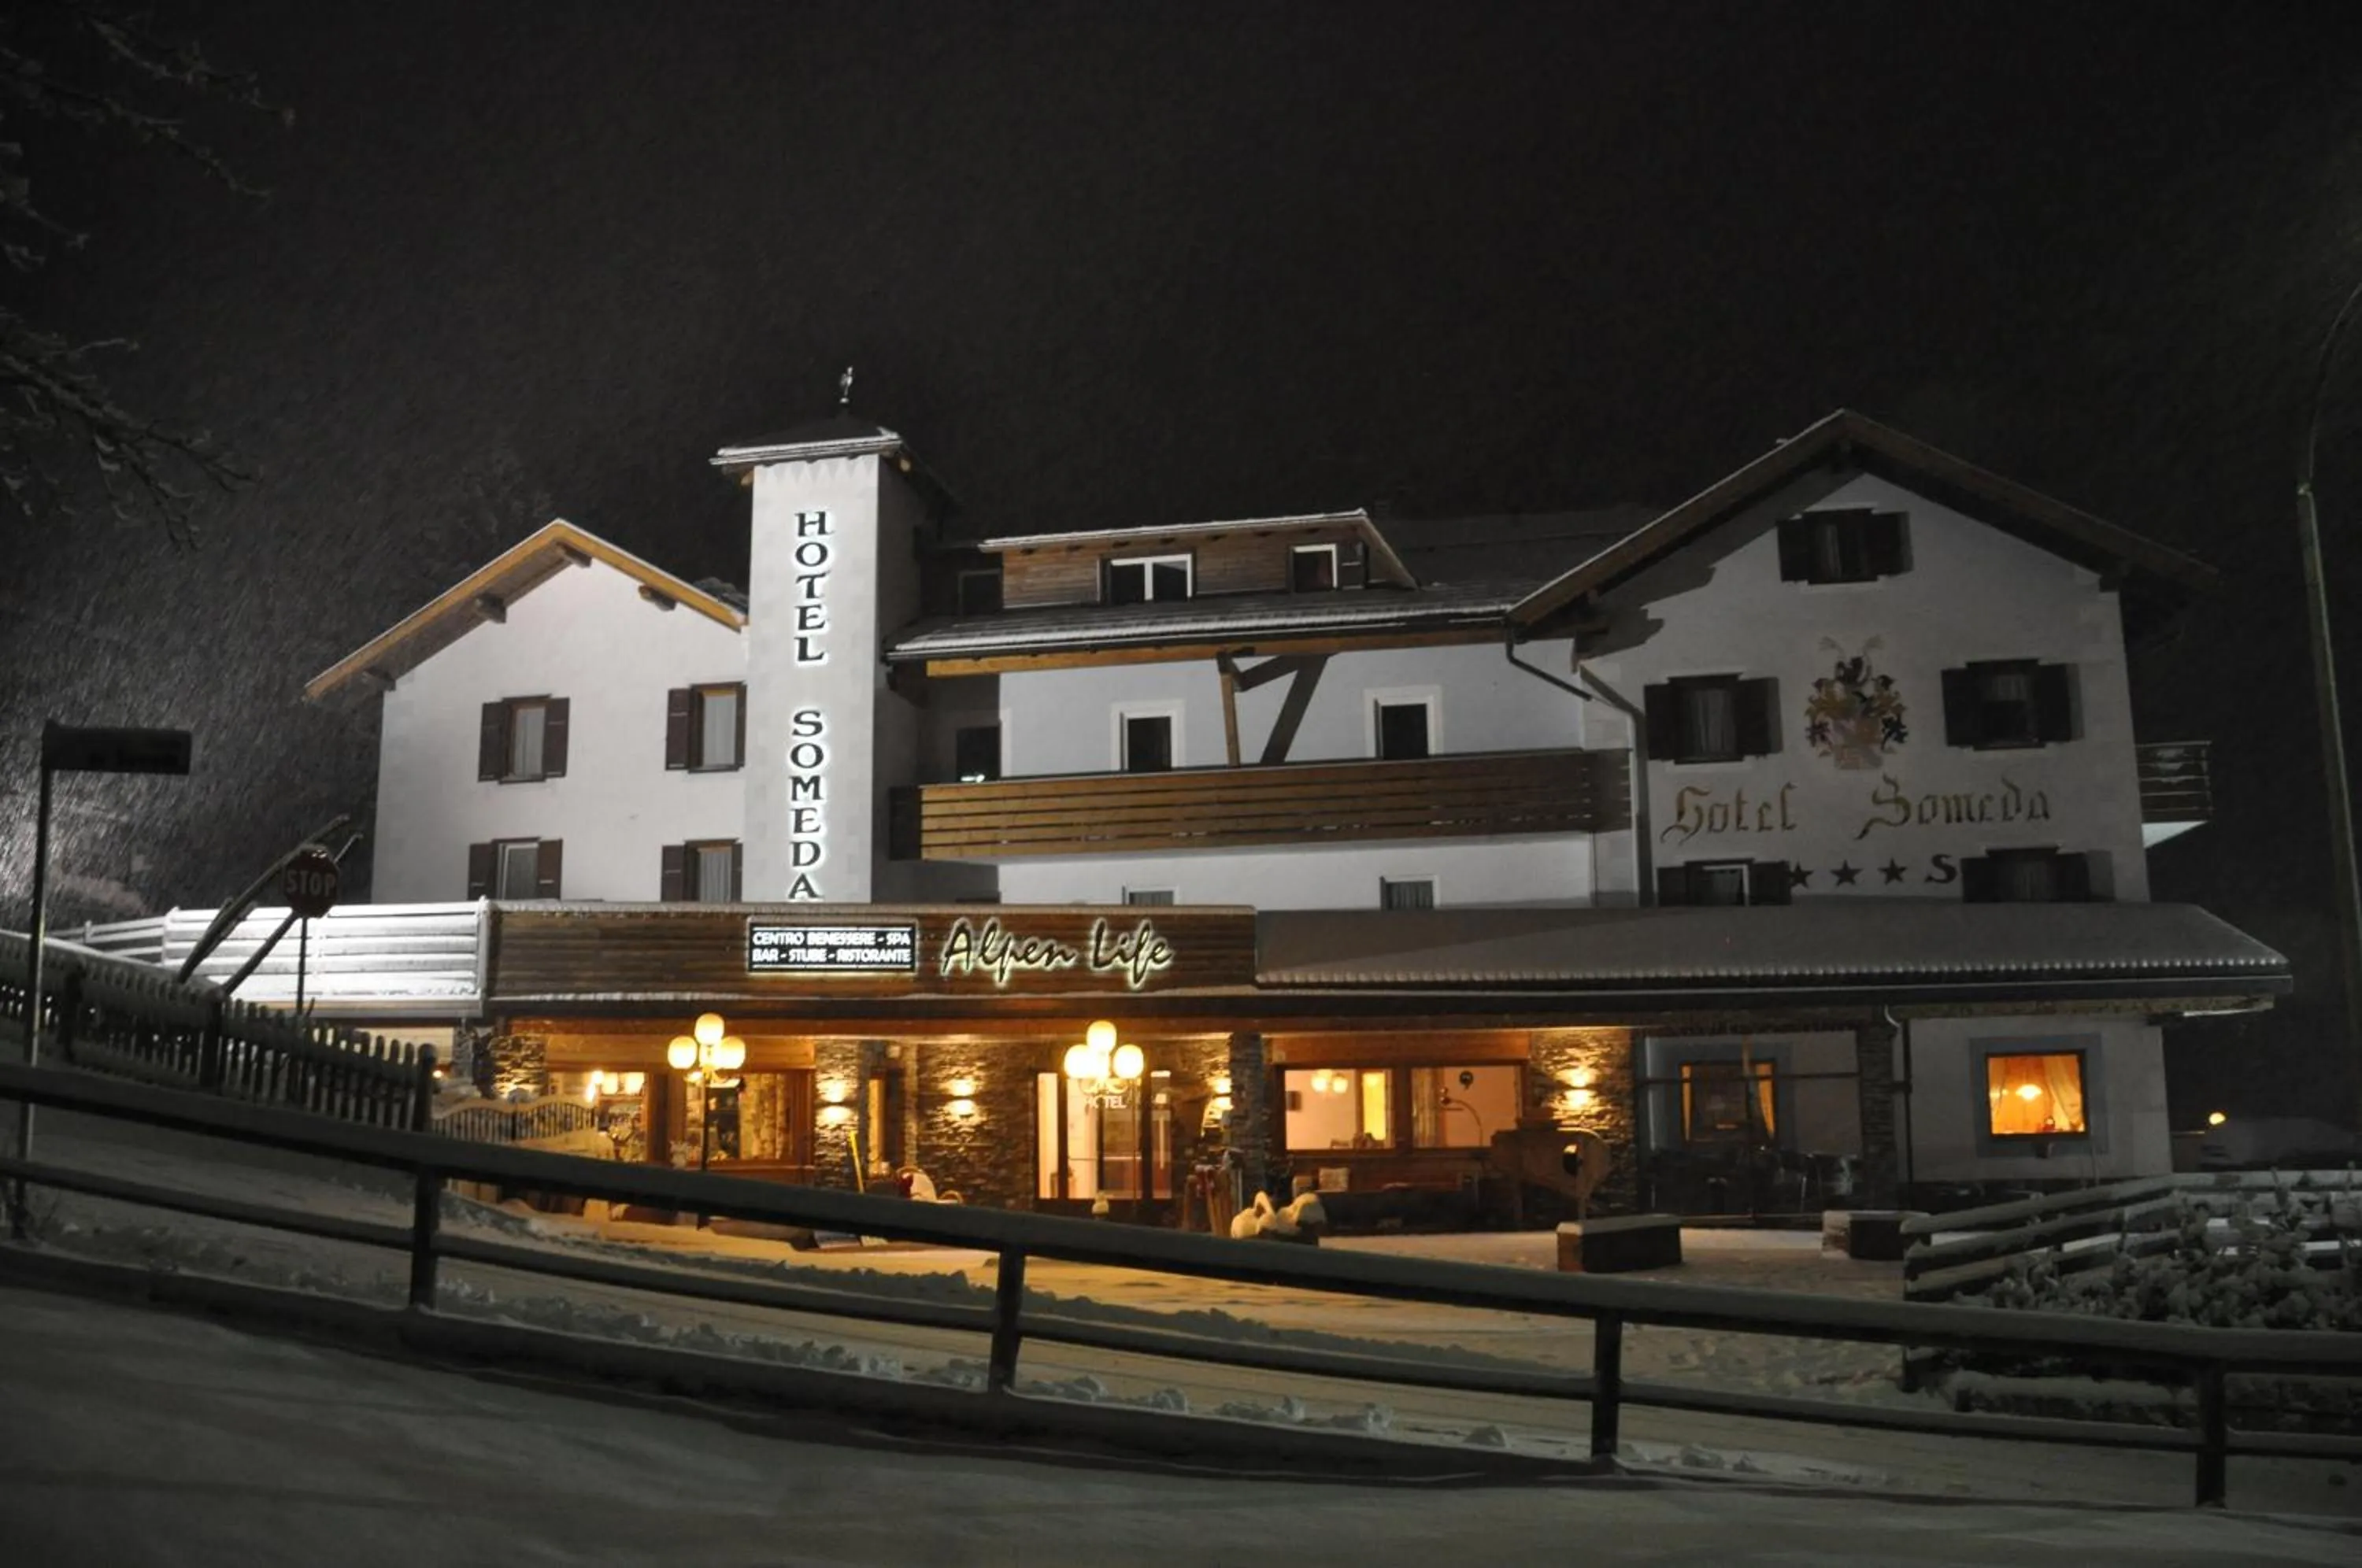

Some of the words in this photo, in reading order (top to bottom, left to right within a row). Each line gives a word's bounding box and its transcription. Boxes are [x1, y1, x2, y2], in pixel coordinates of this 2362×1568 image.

[794, 511, 830, 663] HOTEL
[790, 710, 826, 900] SOMEDA
[1660, 781, 1797, 845] Hotel
[1853, 771, 2051, 840] Someda
[286, 869, 336, 897] STOP
[752, 949, 779, 962] BAR
[788, 949, 827, 962] STUBE
[836, 949, 911, 962] RISTORANTE
[753, 932, 805, 945] CENTRO
[807, 932, 876, 945] BENESSERE
[886, 932, 911, 945] SPA
[942, 920, 1077, 985] Alpen
[1092, 919, 1172, 985] Life
